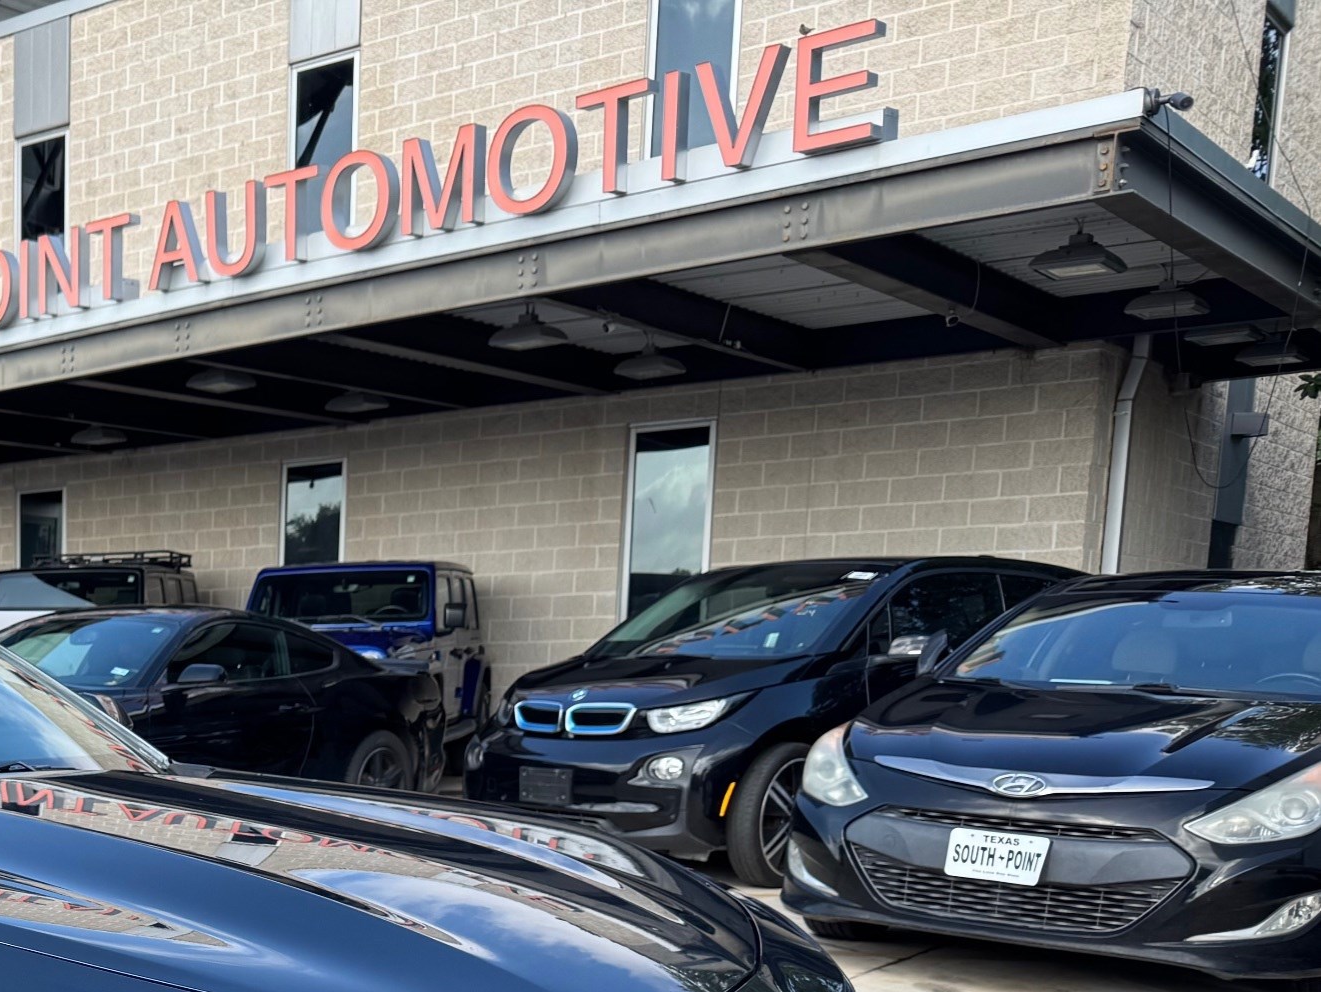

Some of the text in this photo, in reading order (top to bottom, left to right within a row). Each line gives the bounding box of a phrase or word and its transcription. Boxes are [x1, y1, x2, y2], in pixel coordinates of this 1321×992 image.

[149, 18, 888, 290] AUTOMOTIVE
[983, 834, 1020, 847] TEXAS
[952, 843, 997, 868] SOUTH
[1005, 849, 1042, 873] POINT
